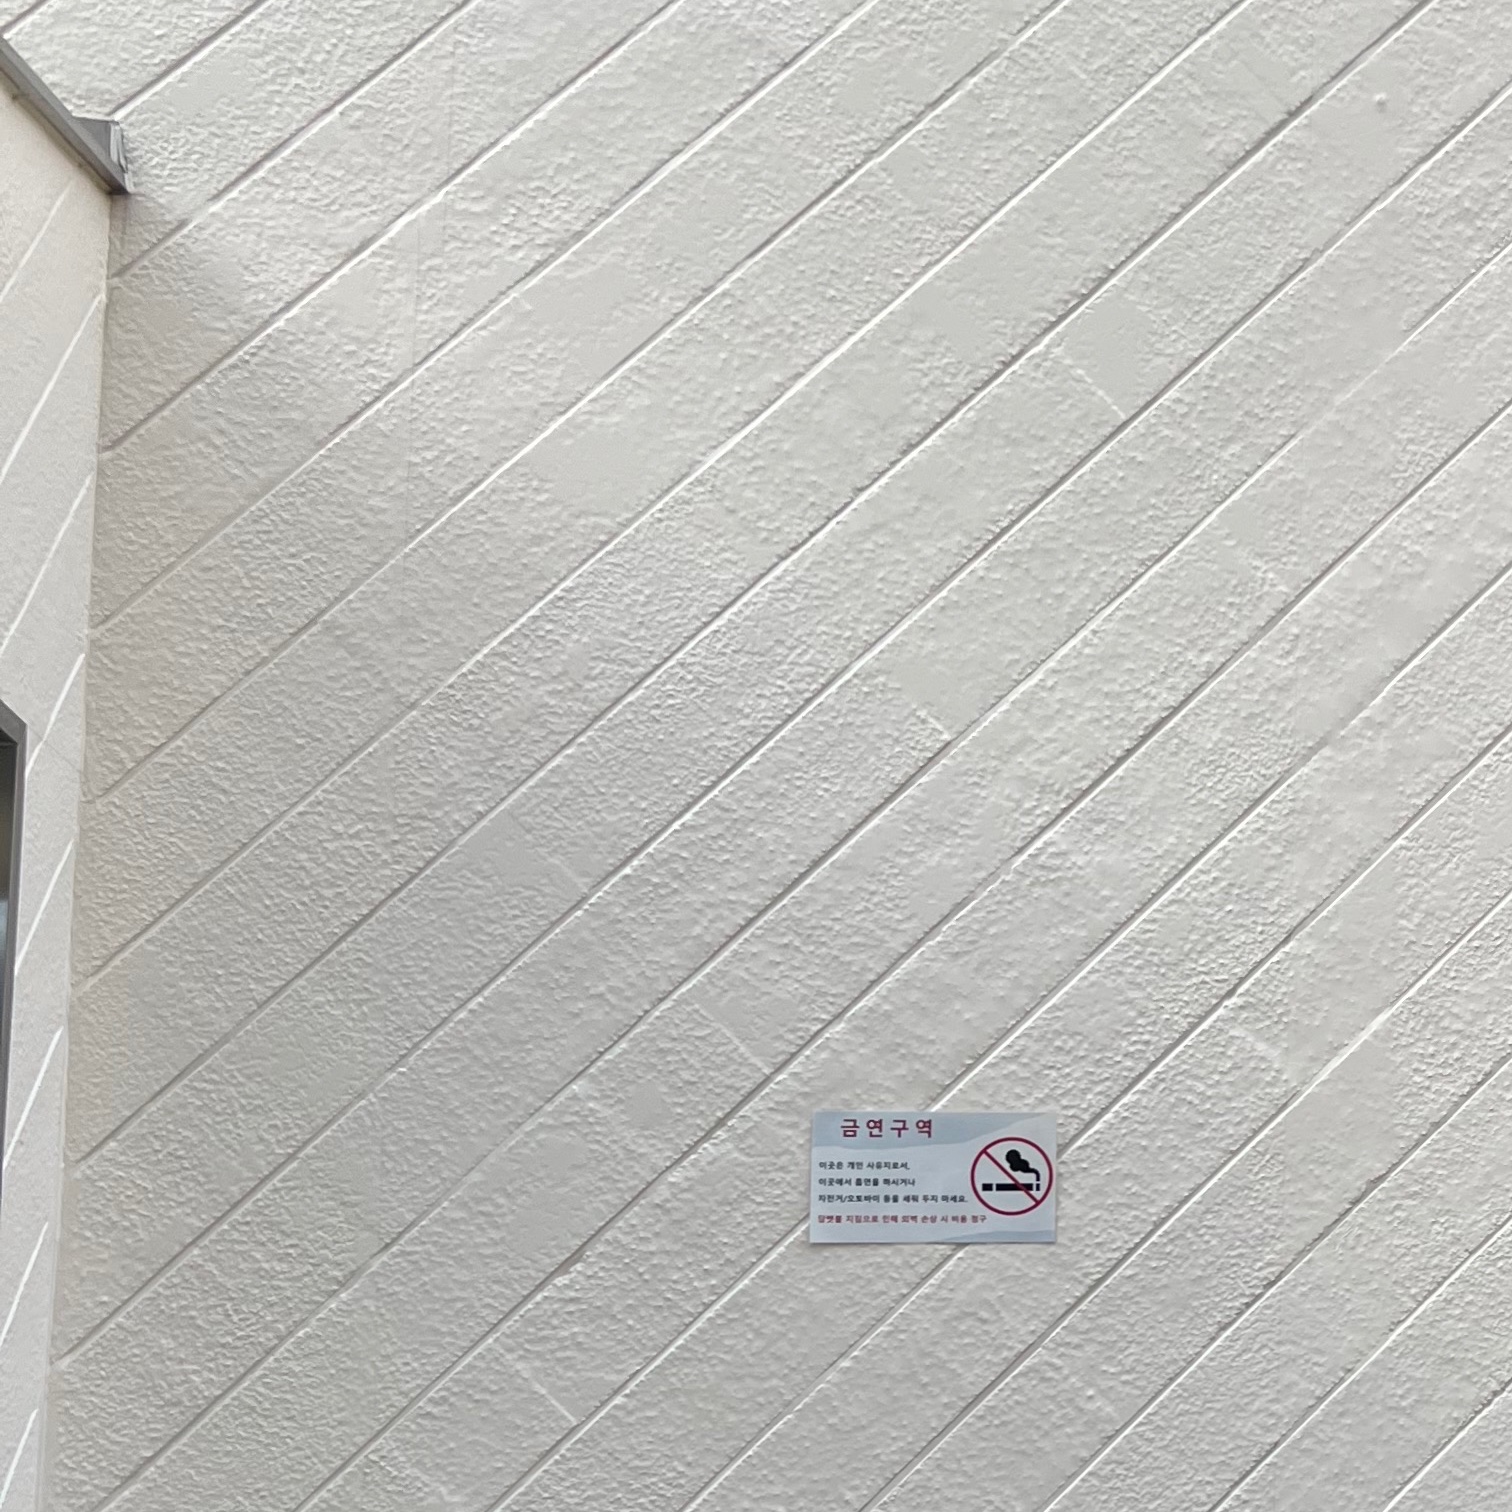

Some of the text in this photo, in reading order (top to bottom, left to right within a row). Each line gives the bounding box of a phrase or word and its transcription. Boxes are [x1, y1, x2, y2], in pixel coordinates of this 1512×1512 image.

[840, 1118, 933, 1139] 금연구역
[818, 1160, 844, 1171] 이곳은
[847, 1160, 864, 1171] 개인
[818, 1177, 916, 1188] 이곳에서 흡연을 하시거나
